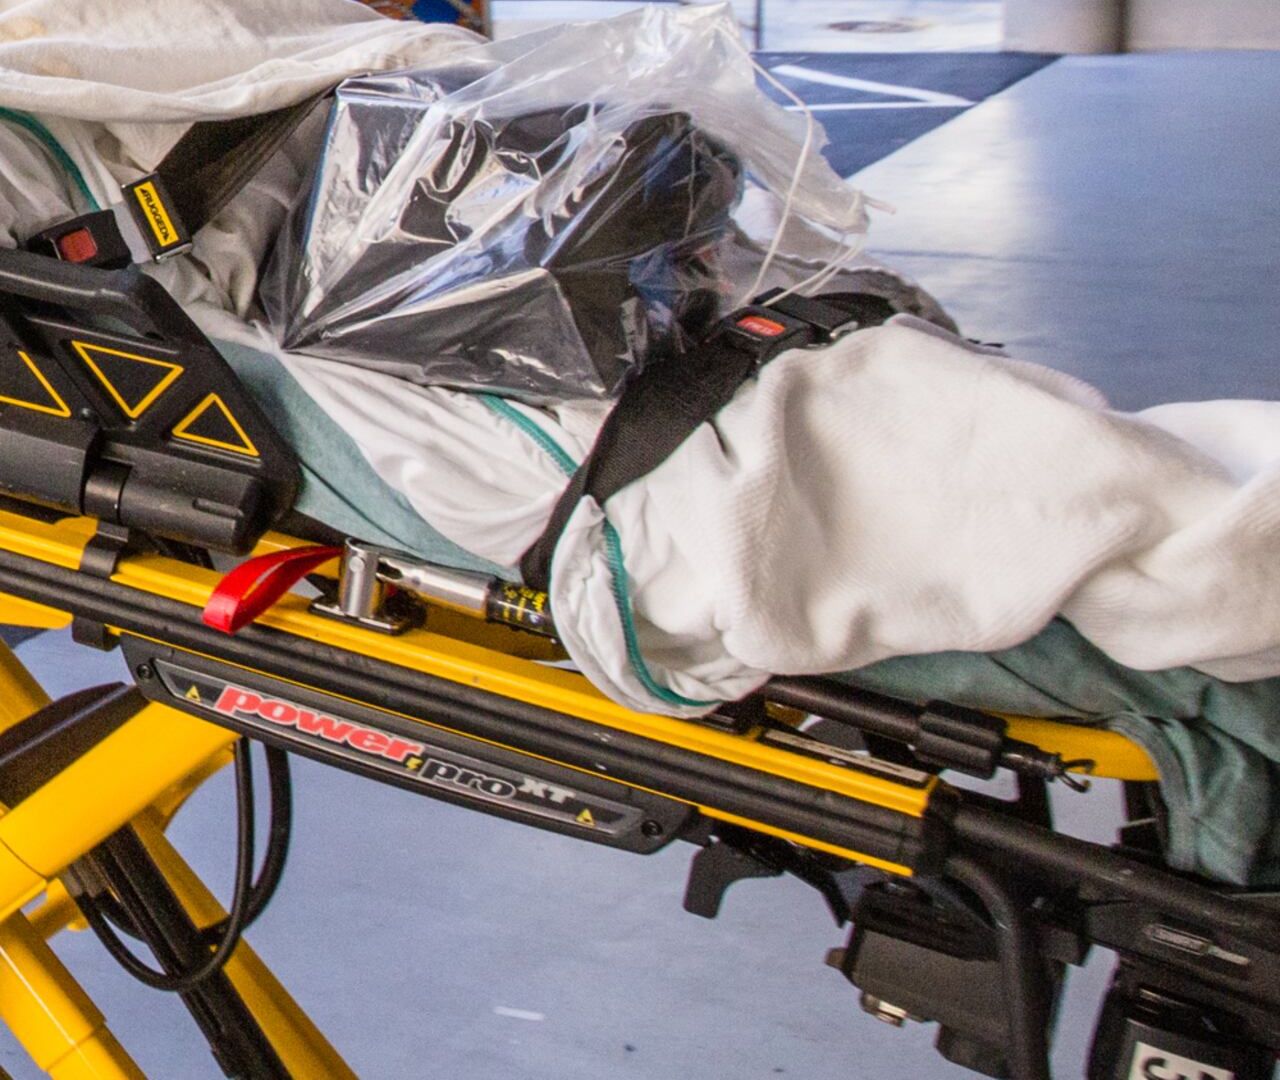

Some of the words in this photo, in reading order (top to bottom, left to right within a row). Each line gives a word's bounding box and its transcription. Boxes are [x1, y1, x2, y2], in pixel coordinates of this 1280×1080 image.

[214, 685, 424, 762] power
[417, 757, 517, 800] pro
[517, 777, 577, 805] XT
